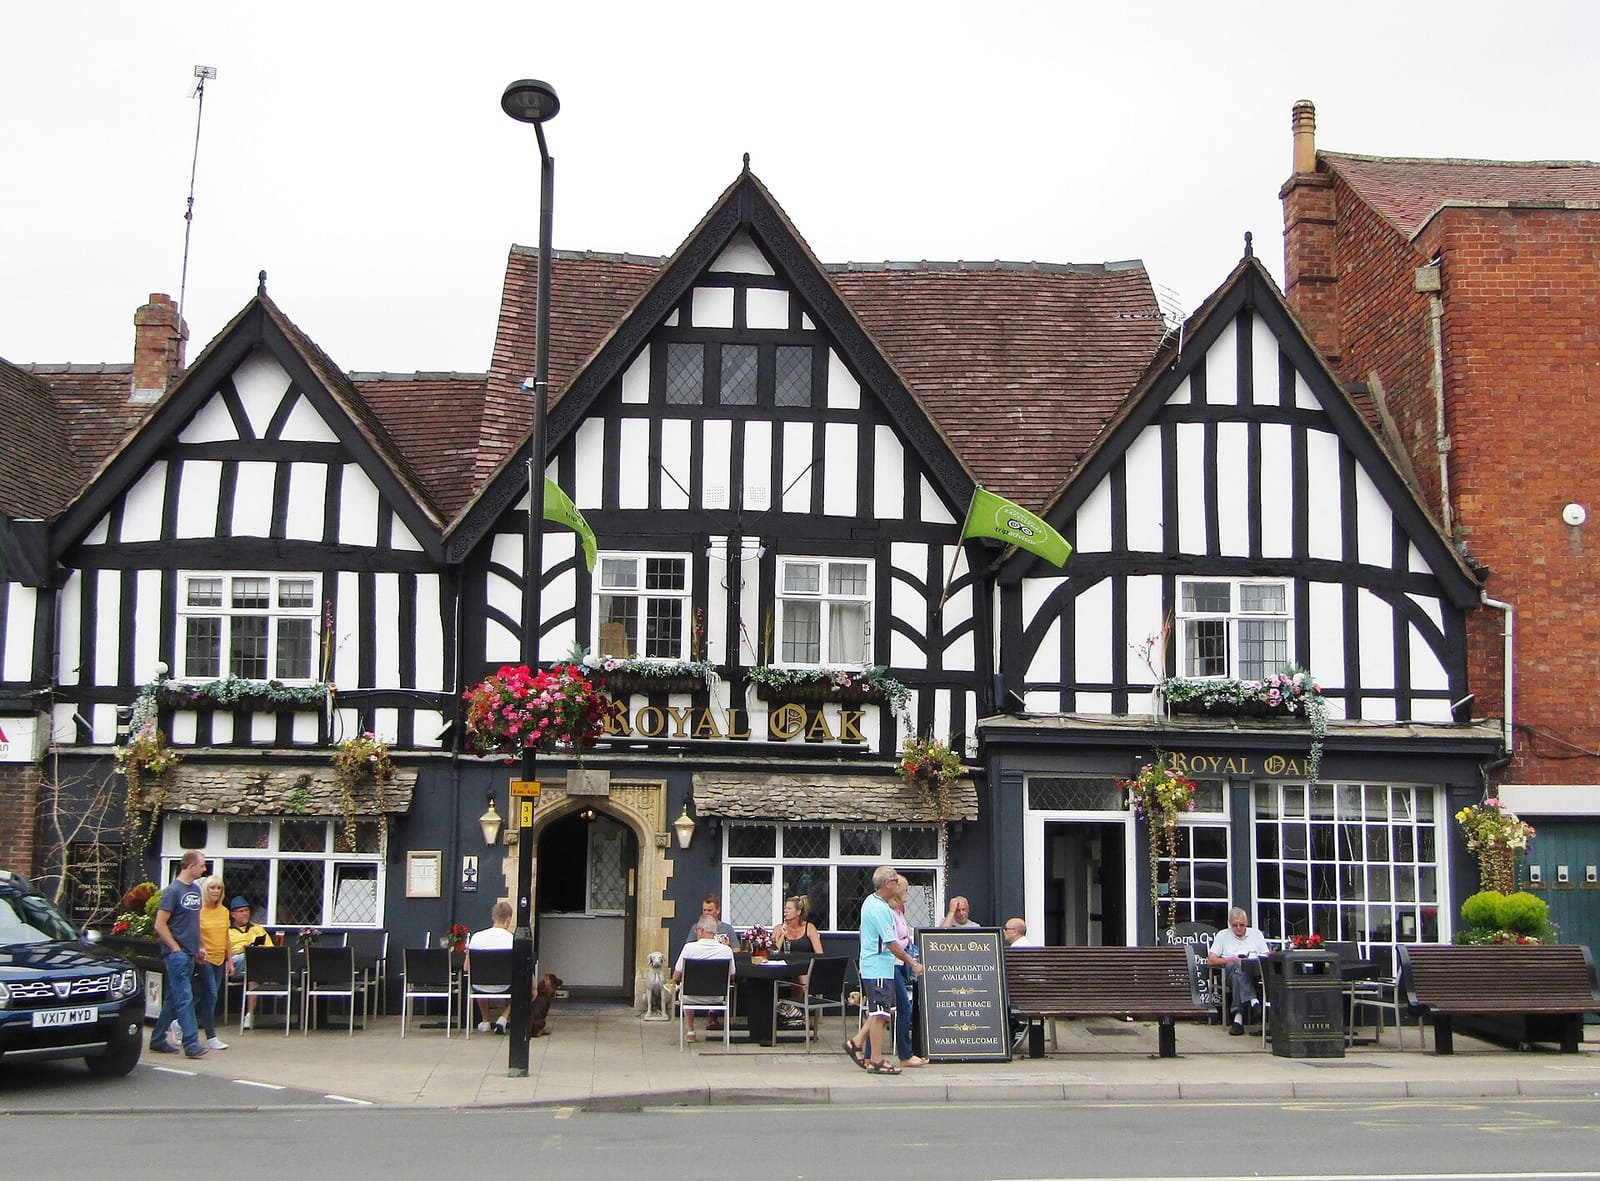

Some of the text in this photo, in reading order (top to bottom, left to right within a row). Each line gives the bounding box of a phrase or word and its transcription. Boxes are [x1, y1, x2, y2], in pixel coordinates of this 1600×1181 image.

[603, 699, 867, 741] ROYAL OAK
[1168, 751, 1255, 775] ROYAL
[1166, 929, 1198, 946] Royal
[929, 941, 991, 952] ROYAL OAK
[41, 1009, 91, 1025] VX17 MYD
[959, 1037, 999, 1045] WELCOME
